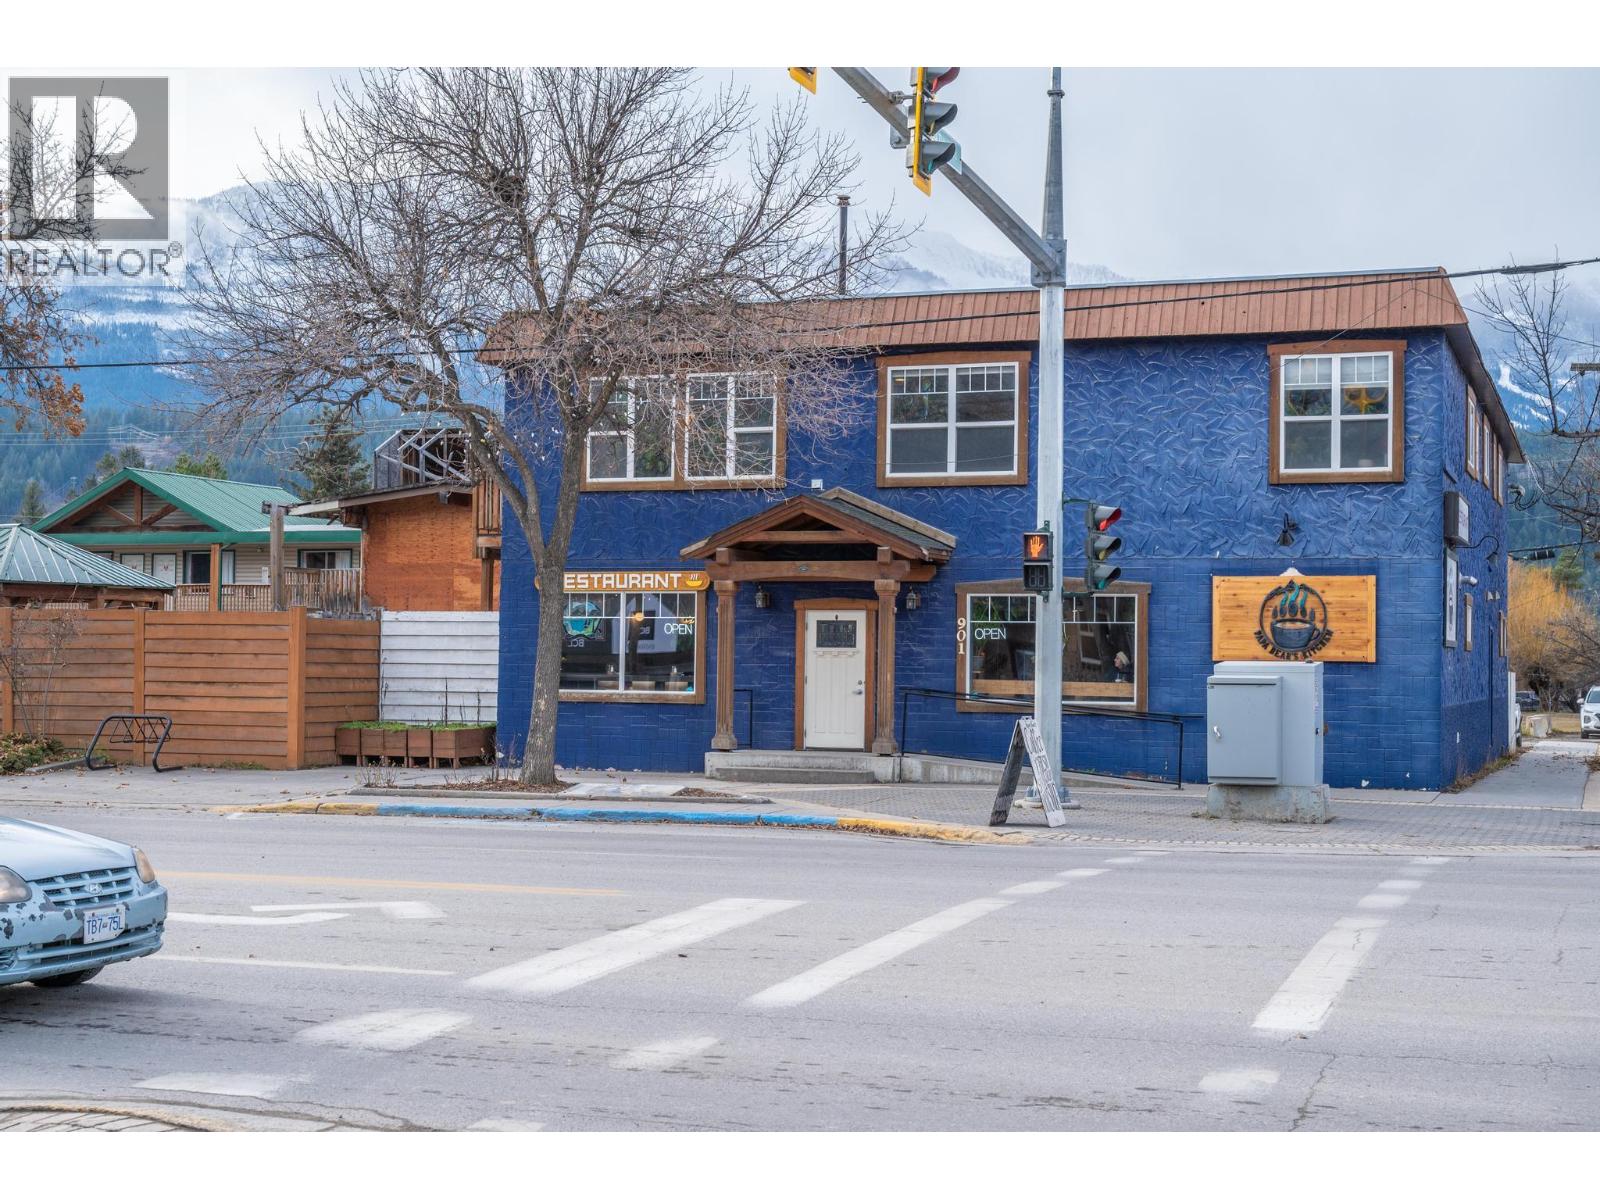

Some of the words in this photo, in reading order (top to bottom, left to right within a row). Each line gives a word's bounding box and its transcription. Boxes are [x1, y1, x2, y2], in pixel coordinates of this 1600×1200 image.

[563, 573, 682, 589] ESTAURANT
[664, 623, 693, 635] OPEN
[956, 617, 966, 655] 901
[974, 627, 1006, 640] OPEN
